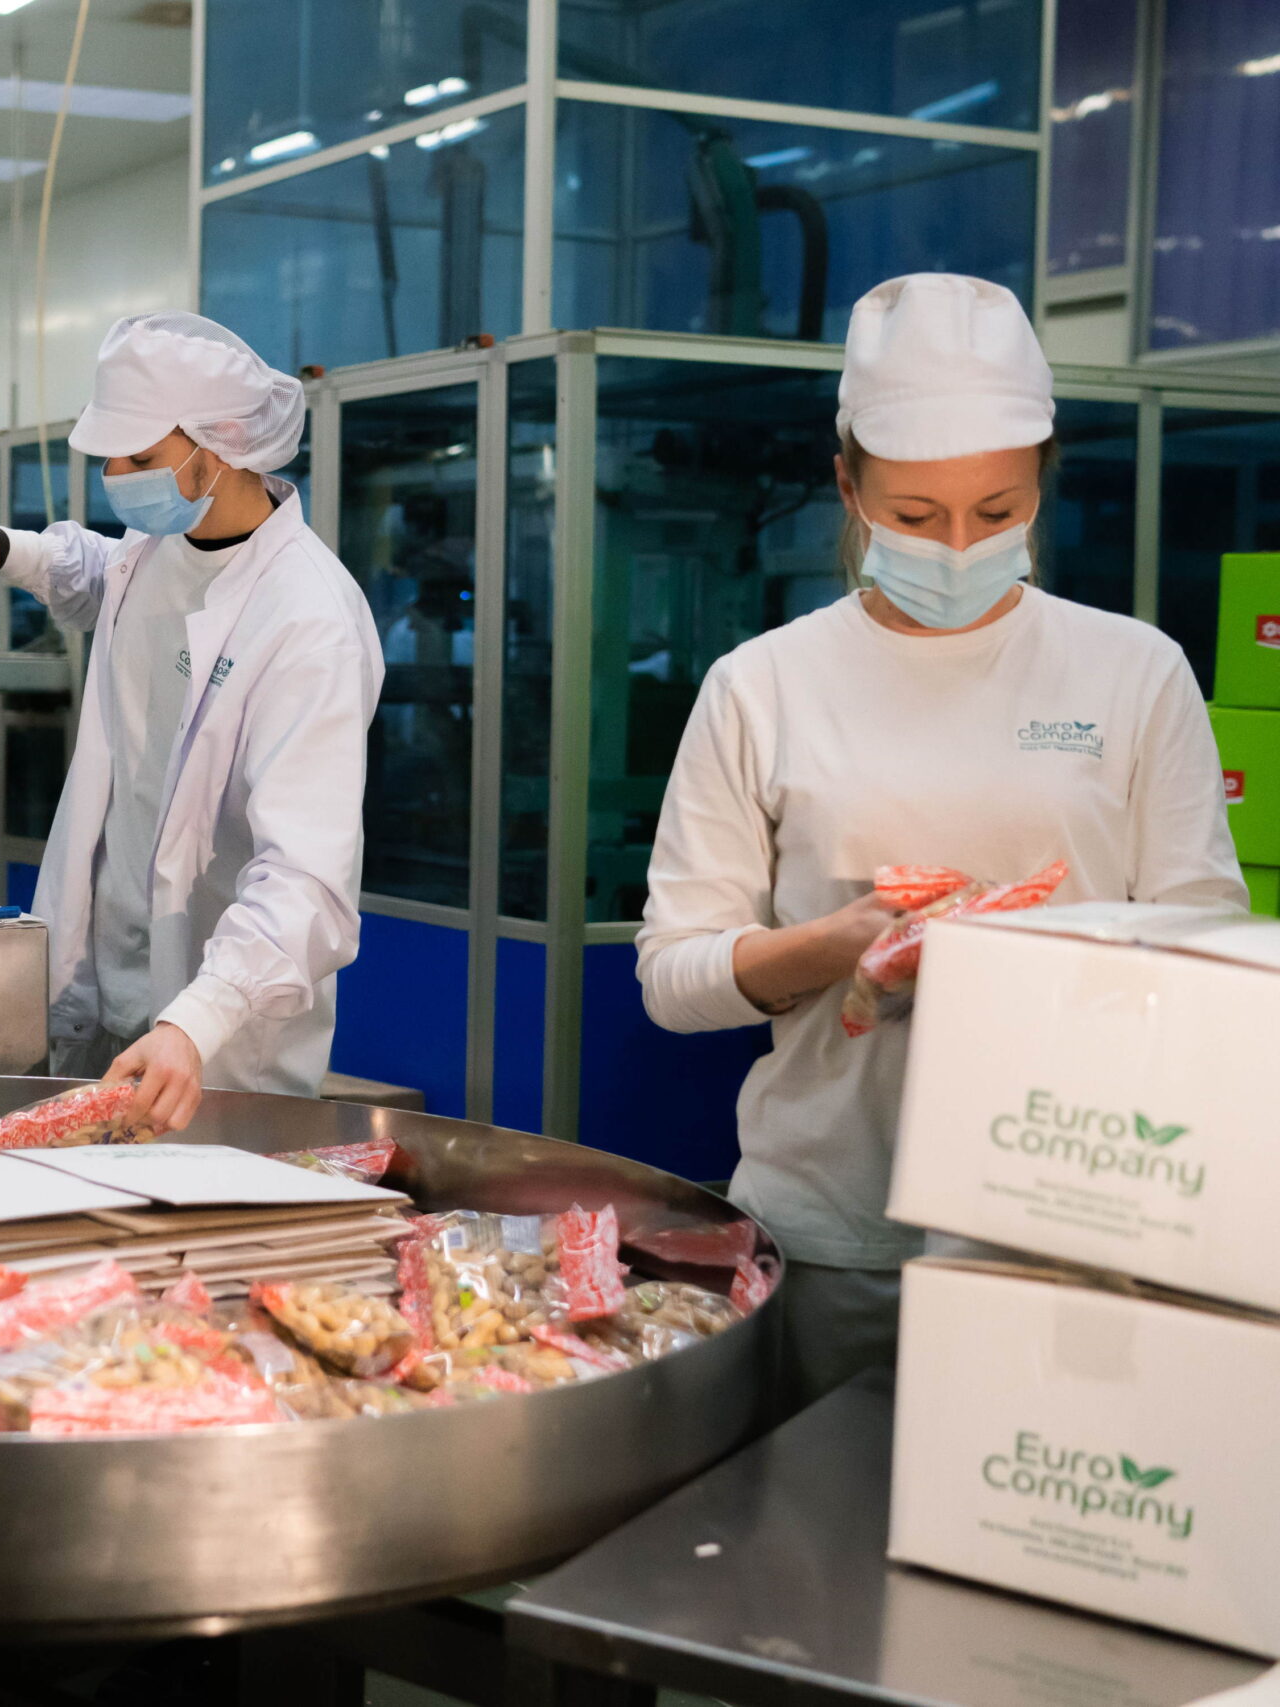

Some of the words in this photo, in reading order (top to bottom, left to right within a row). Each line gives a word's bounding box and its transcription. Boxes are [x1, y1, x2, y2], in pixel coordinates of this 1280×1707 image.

[1017, 728, 1104, 748] Company
[1029, 720, 1073, 732] Euro
[1025, 1088, 1127, 1140] Euro
[989, 1113, 1206, 1197] Company
[1016, 1430, 1114, 1482] Euro
[982, 1454, 1193, 1540] Company
